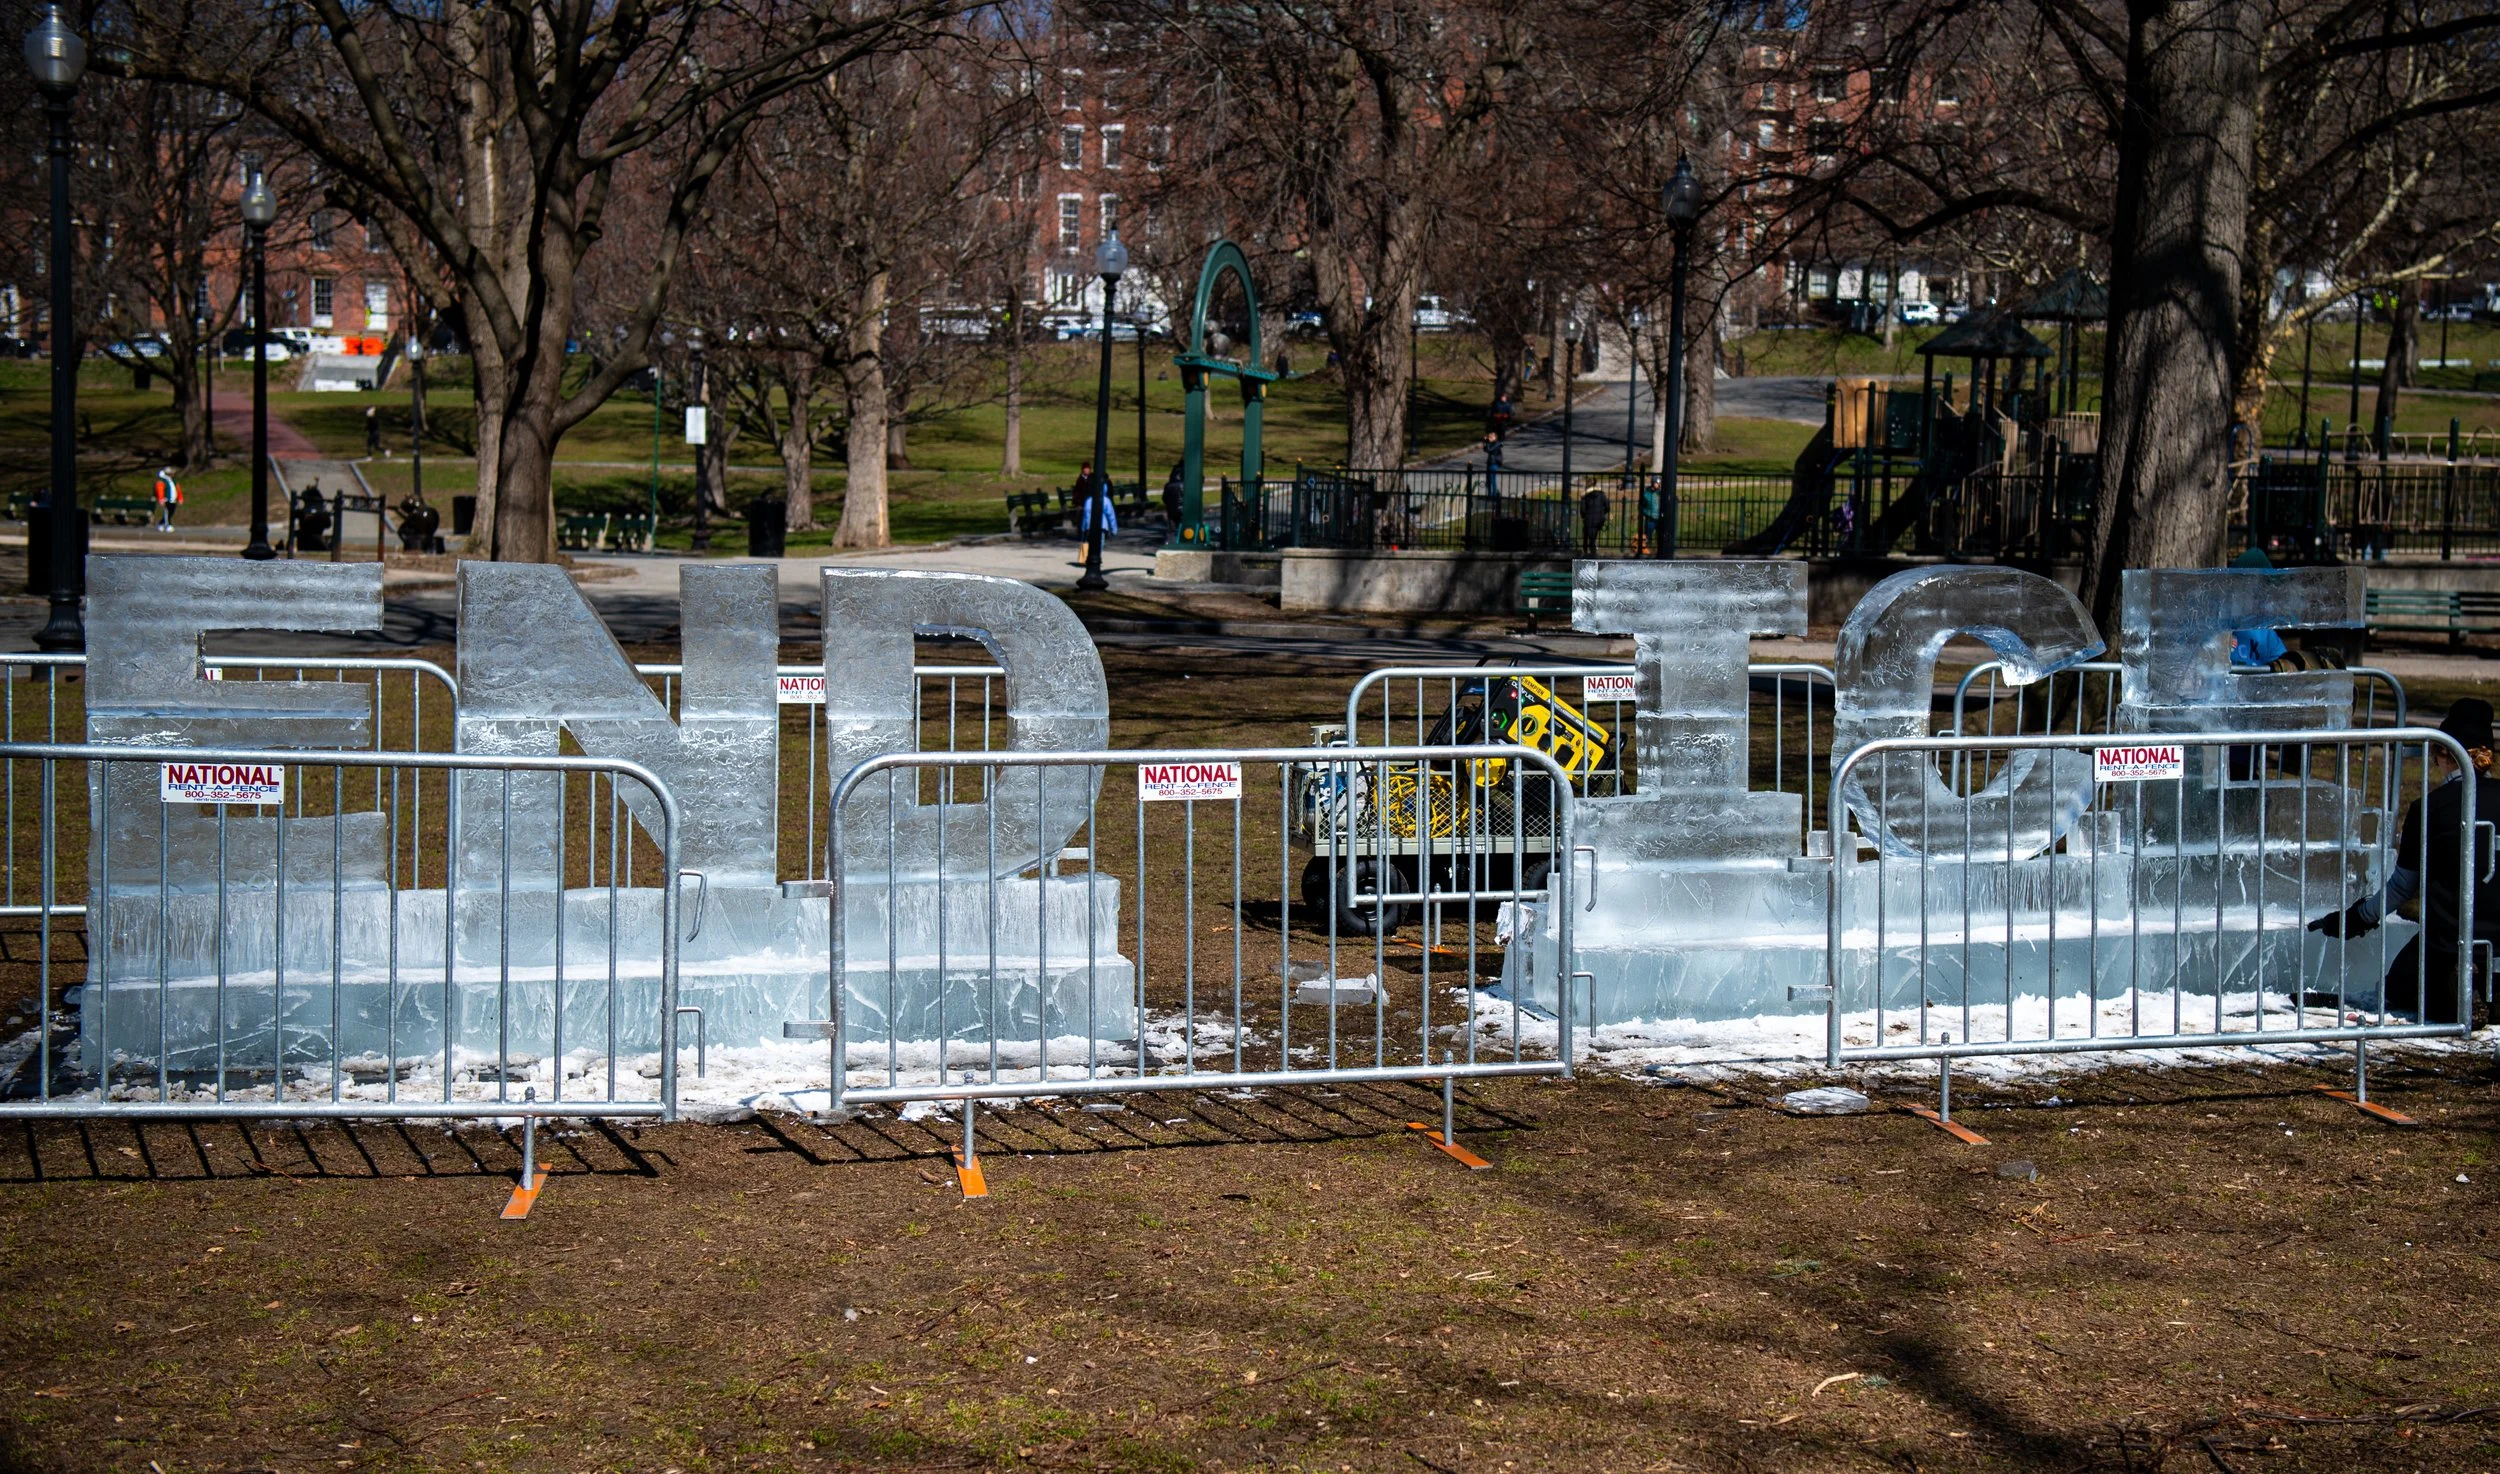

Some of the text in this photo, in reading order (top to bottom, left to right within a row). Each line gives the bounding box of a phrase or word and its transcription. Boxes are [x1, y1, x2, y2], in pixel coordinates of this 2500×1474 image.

[1587, 676, 1635, 689] NATION
[84, 555, 2367, 891] END ICE
[2100, 747, 2180, 765] NATIONAL
[2100, 763, 2179, 771] RENT-A-FENCE
[168, 764, 280, 786] NATIONAL
[1145, 764, 1237, 783] NATIONAL
[2111, 769, 2167, 777] 800-352-5675
[168, 784, 278, 792] RENT-A-FENCE
[1145, 782, 1236, 790] RENT-A-FENCE
[184, 791, 262, 799] 800-352-5675
[1158, 788, 1223, 796] 800-352-5675
